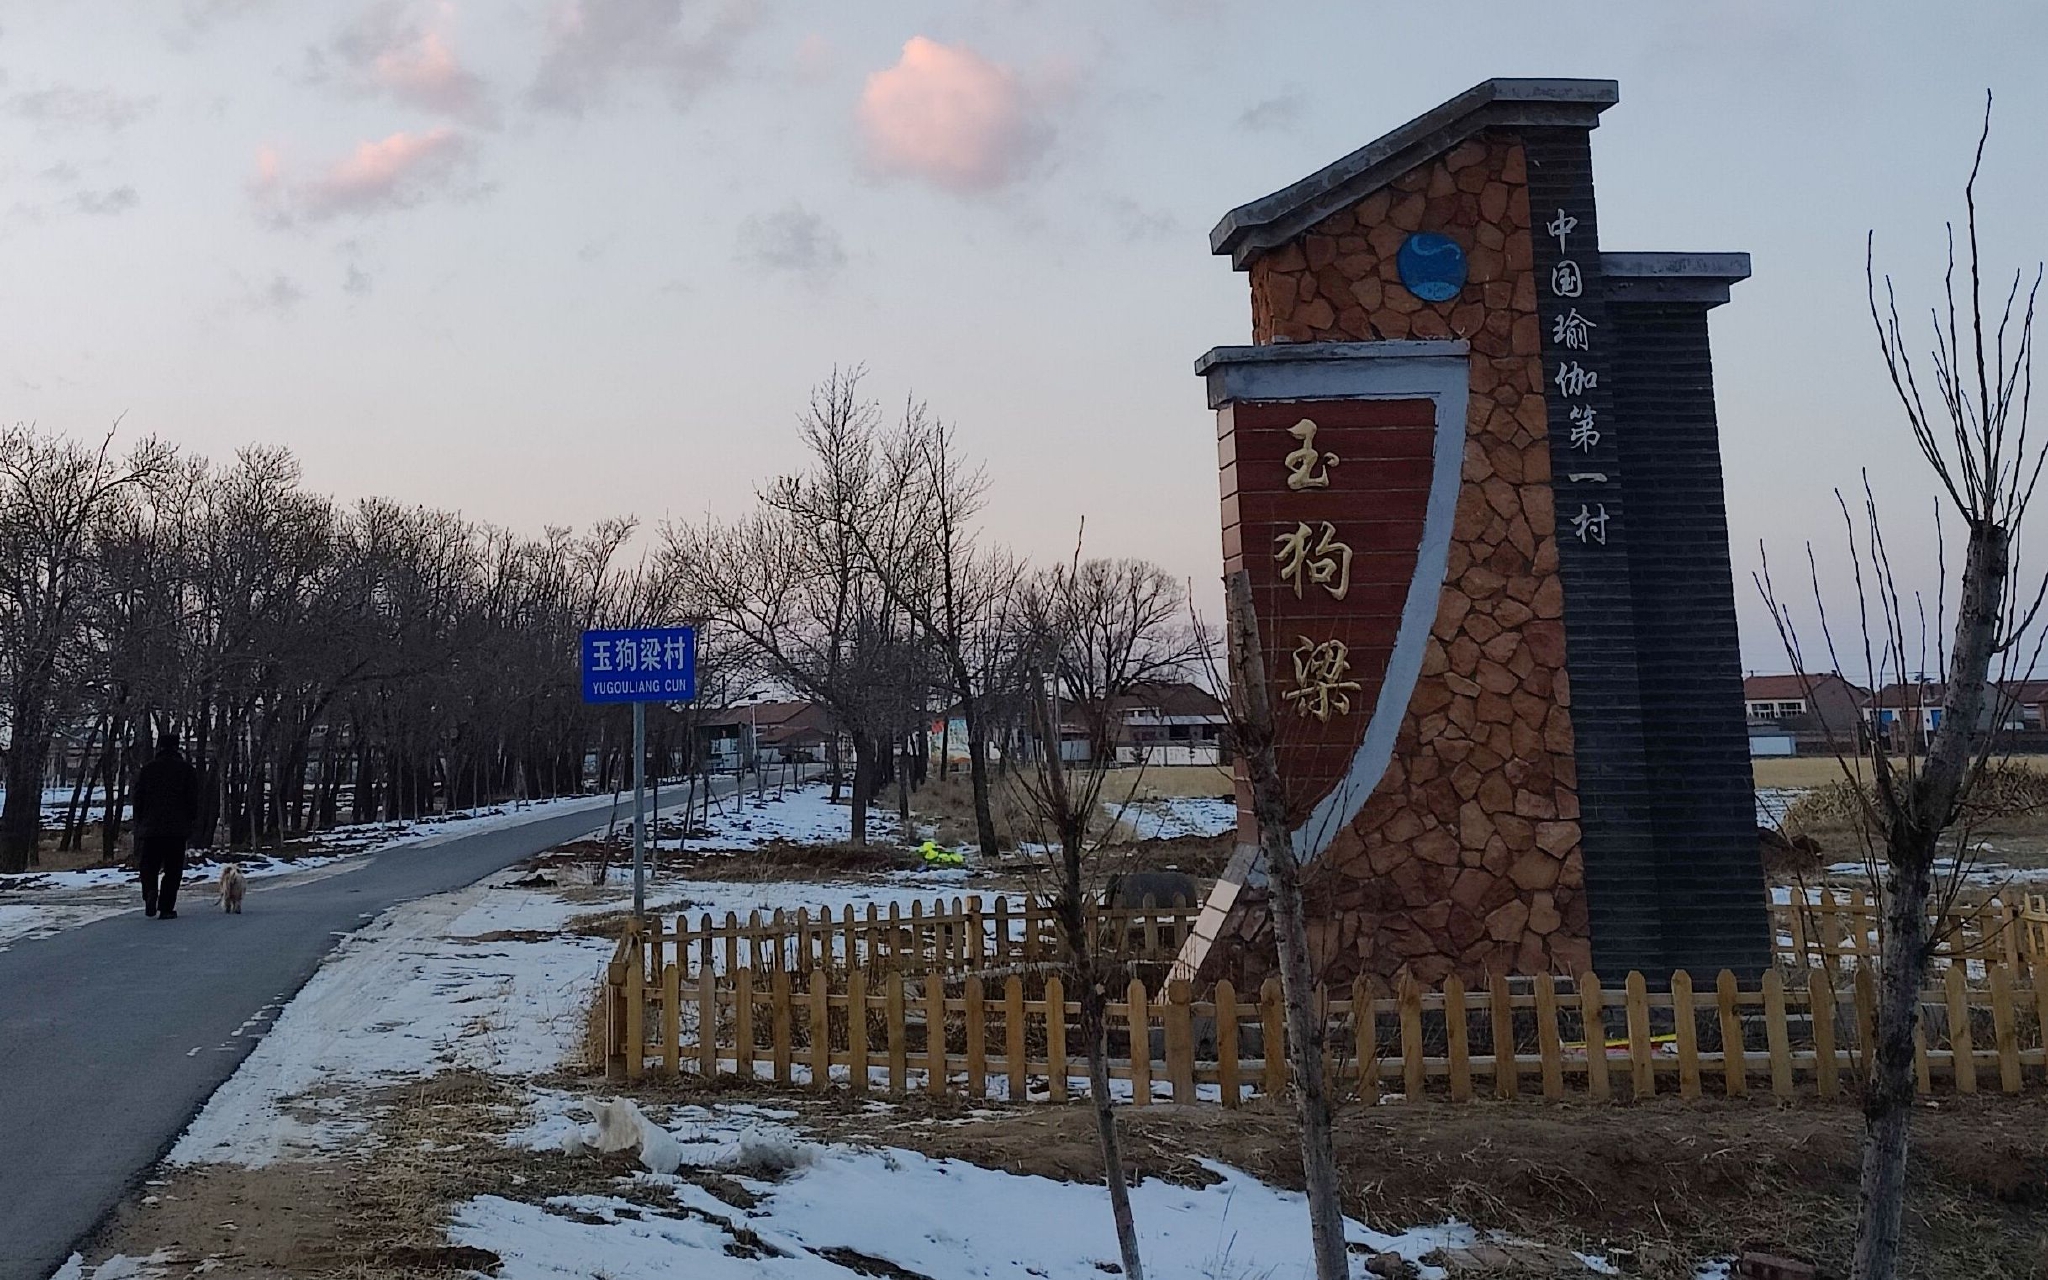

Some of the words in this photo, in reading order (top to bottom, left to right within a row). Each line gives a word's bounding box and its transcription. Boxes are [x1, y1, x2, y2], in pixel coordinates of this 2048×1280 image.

[1546, 208, 1611, 545] 中国瑜伽第一村
[592, 636, 685, 672] 玉狗梁村
[1273, 418, 1362, 723] 玉狗梁
[592, 680, 660, 695] YUGOULIANG
[664, 679, 686, 692] CUN
